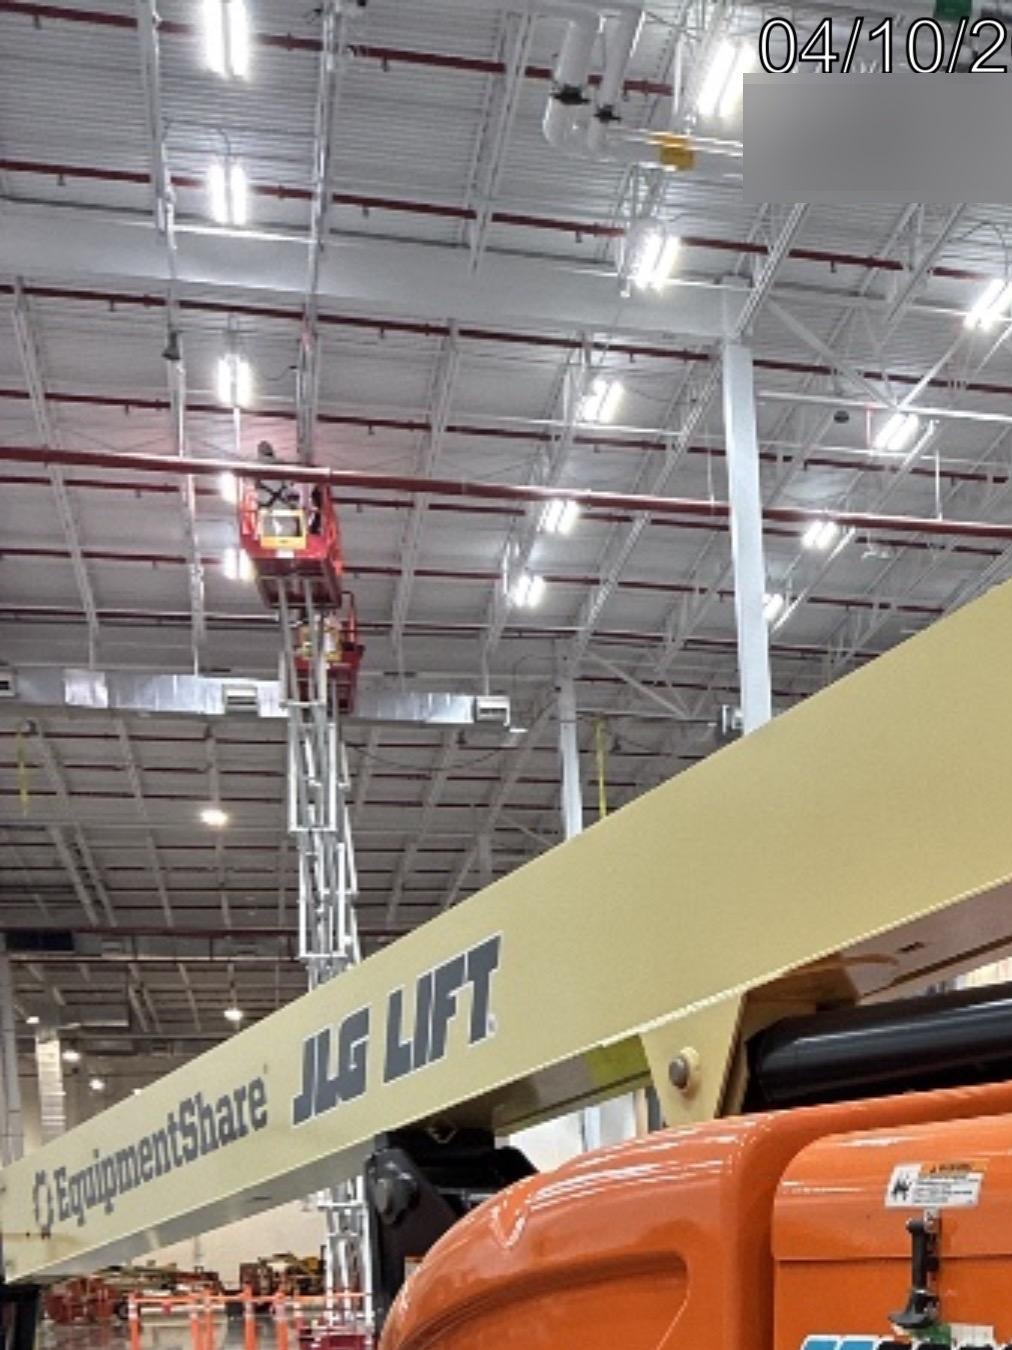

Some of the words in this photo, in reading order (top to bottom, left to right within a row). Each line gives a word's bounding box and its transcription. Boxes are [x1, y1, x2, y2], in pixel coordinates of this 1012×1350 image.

[292, 1006, 371, 1127] JLG
[383, 932, 503, 1084] LIFT
[52, 1074, 268, 1227] EquipmentShare
